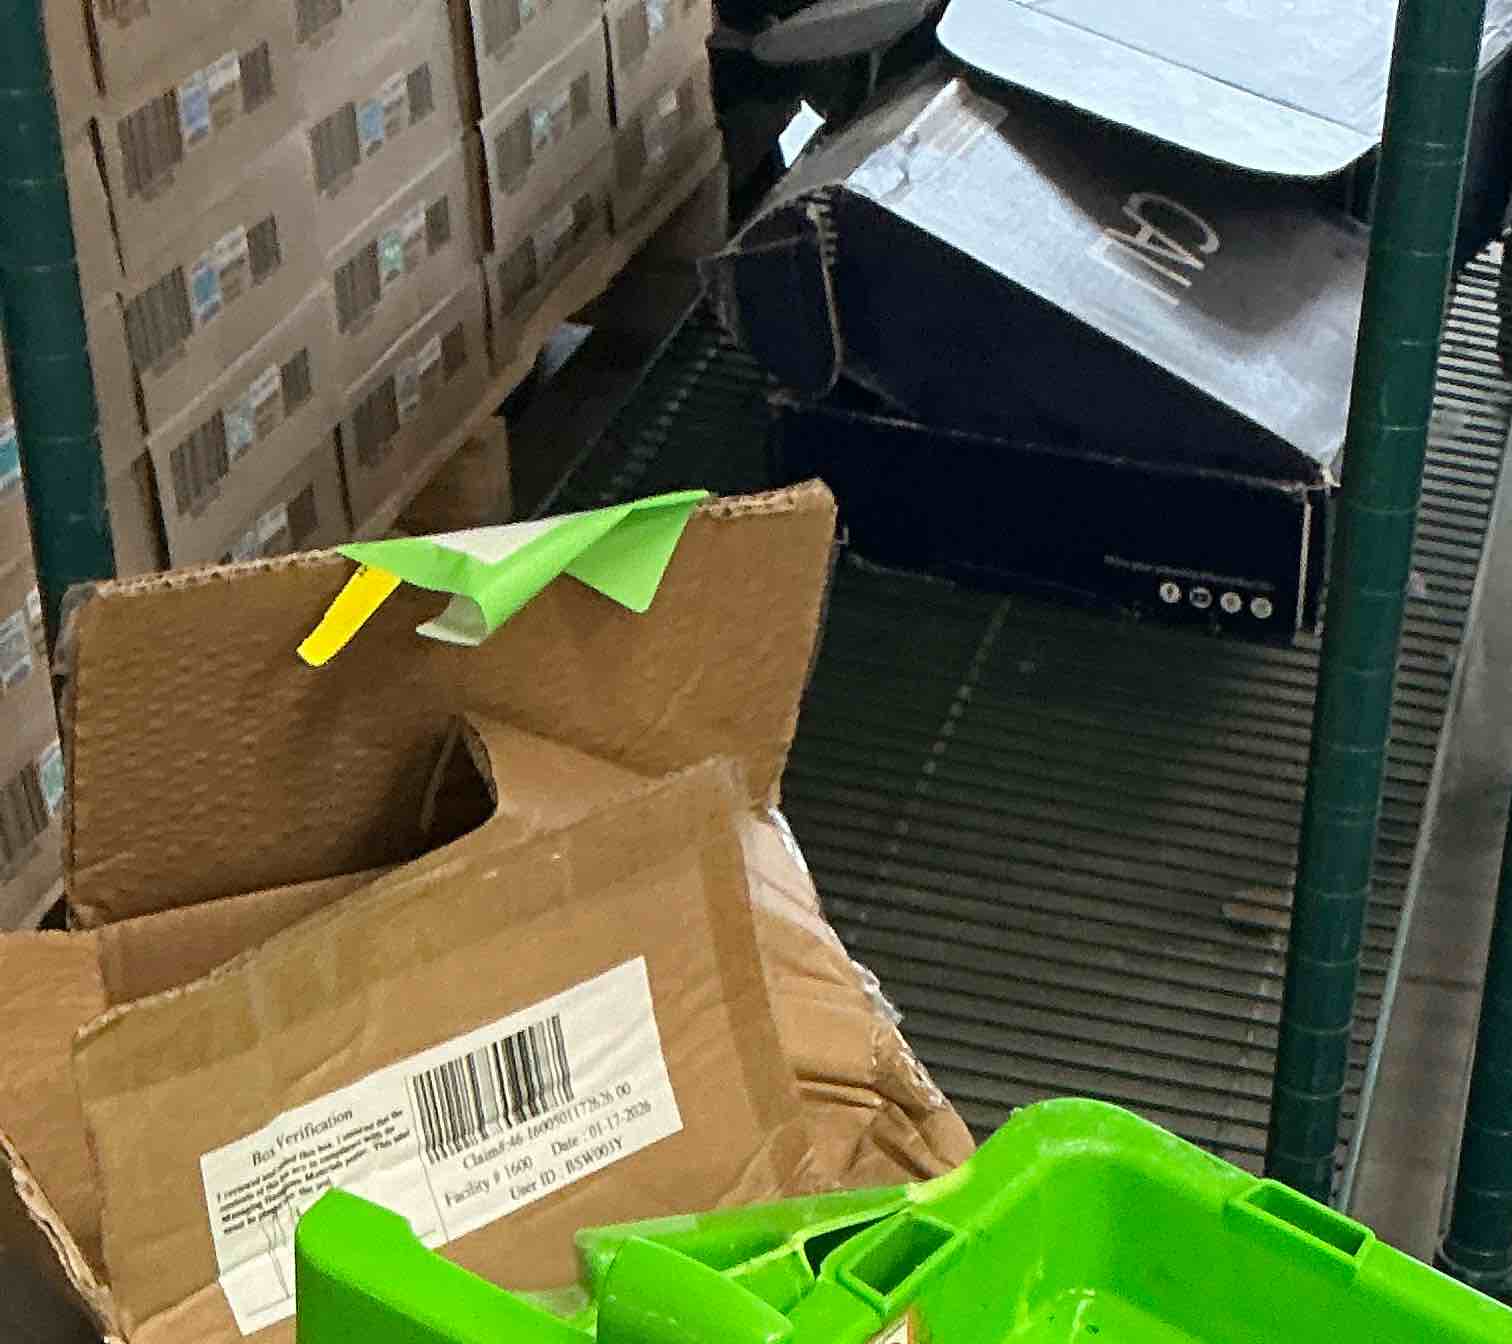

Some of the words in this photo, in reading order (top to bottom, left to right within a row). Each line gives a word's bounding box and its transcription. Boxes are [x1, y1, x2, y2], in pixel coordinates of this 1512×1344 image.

[251, 1148, 276, 1169] Box
[275, 1108, 353, 1150] Verification
[551, 1134, 579, 1156] Date
[444, 1175, 490, 1206] Facility
[504, 1155, 534, 1178] 1600
[509, 1180, 538, 1201] User
[539, 1169, 557, 1186] ID
